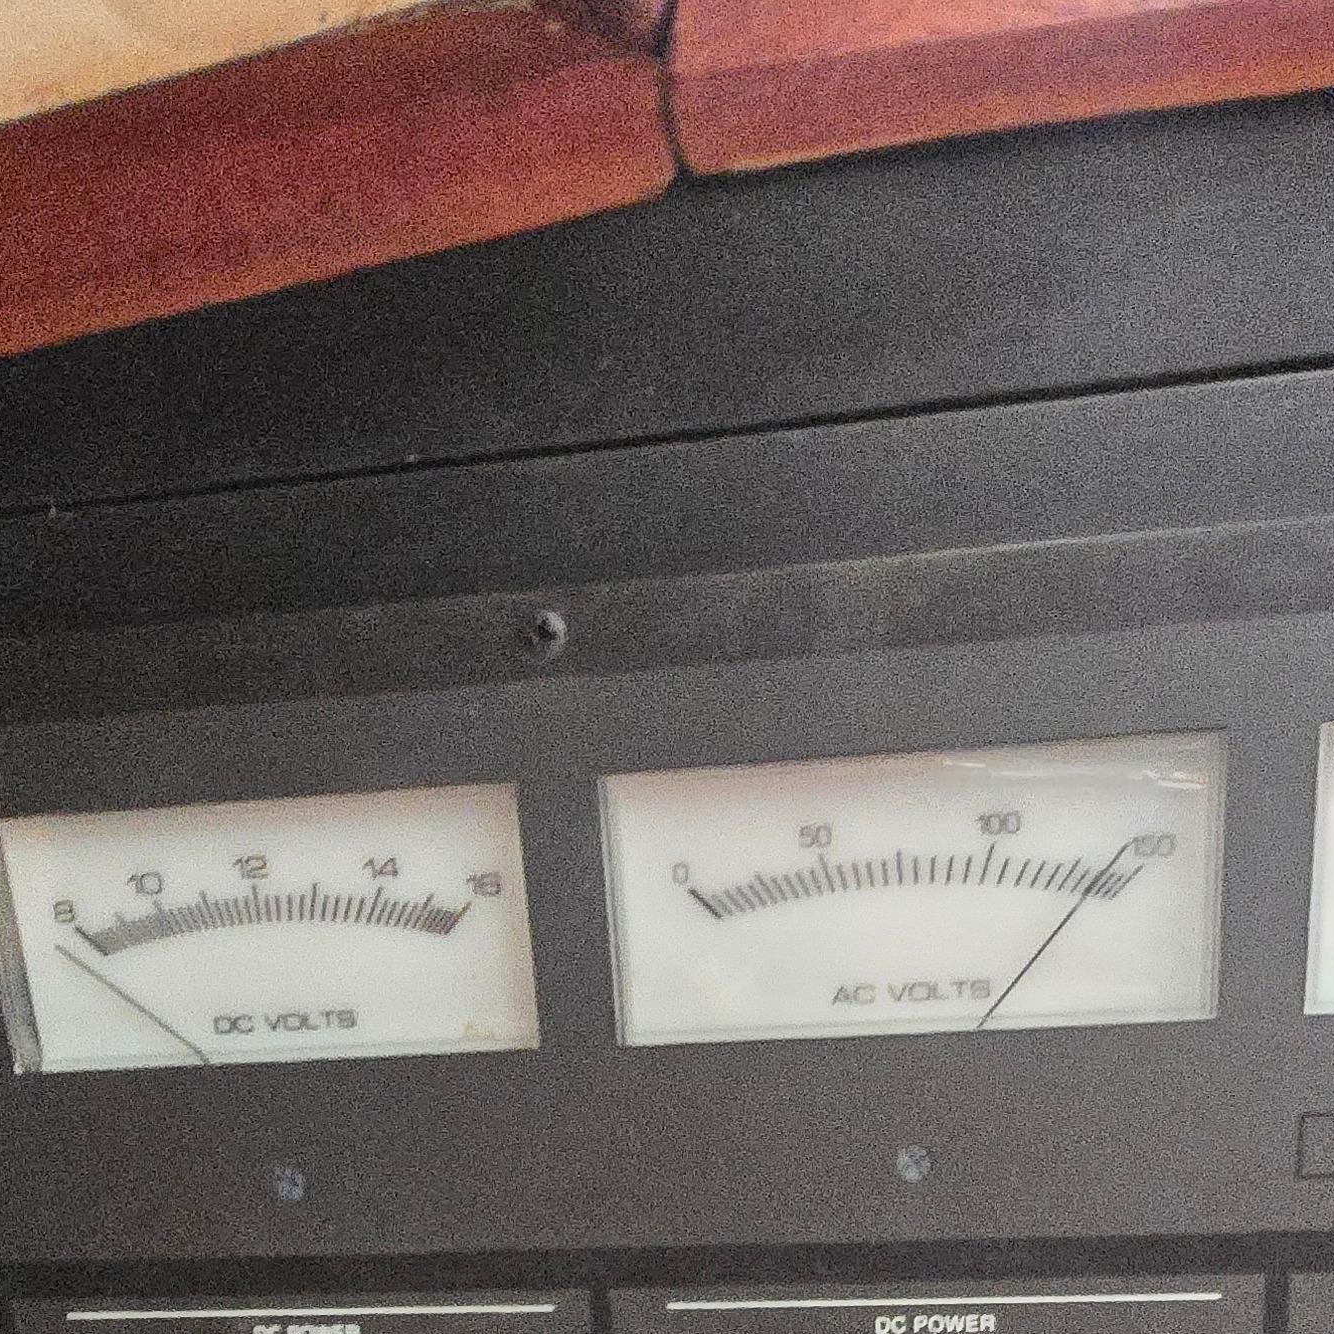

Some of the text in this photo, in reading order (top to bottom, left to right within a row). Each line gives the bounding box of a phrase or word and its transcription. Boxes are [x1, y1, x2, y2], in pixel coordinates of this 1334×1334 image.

[798, 823, 833, 849] 50
[975, 810, 1023, 837] 100
[232, 853, 269, 880] 12
[362, 855, 400, 879] 14
[672, 861, 690, 887] 0
[127, 870, 164, 896] 10
[53, 898, 76, 925] 8
[832, 977, 994, 1008] AC VOLTS
[213, 1008, 359, 1037] DC VOLTS
[913, 1313, 997, 1334] POWER
